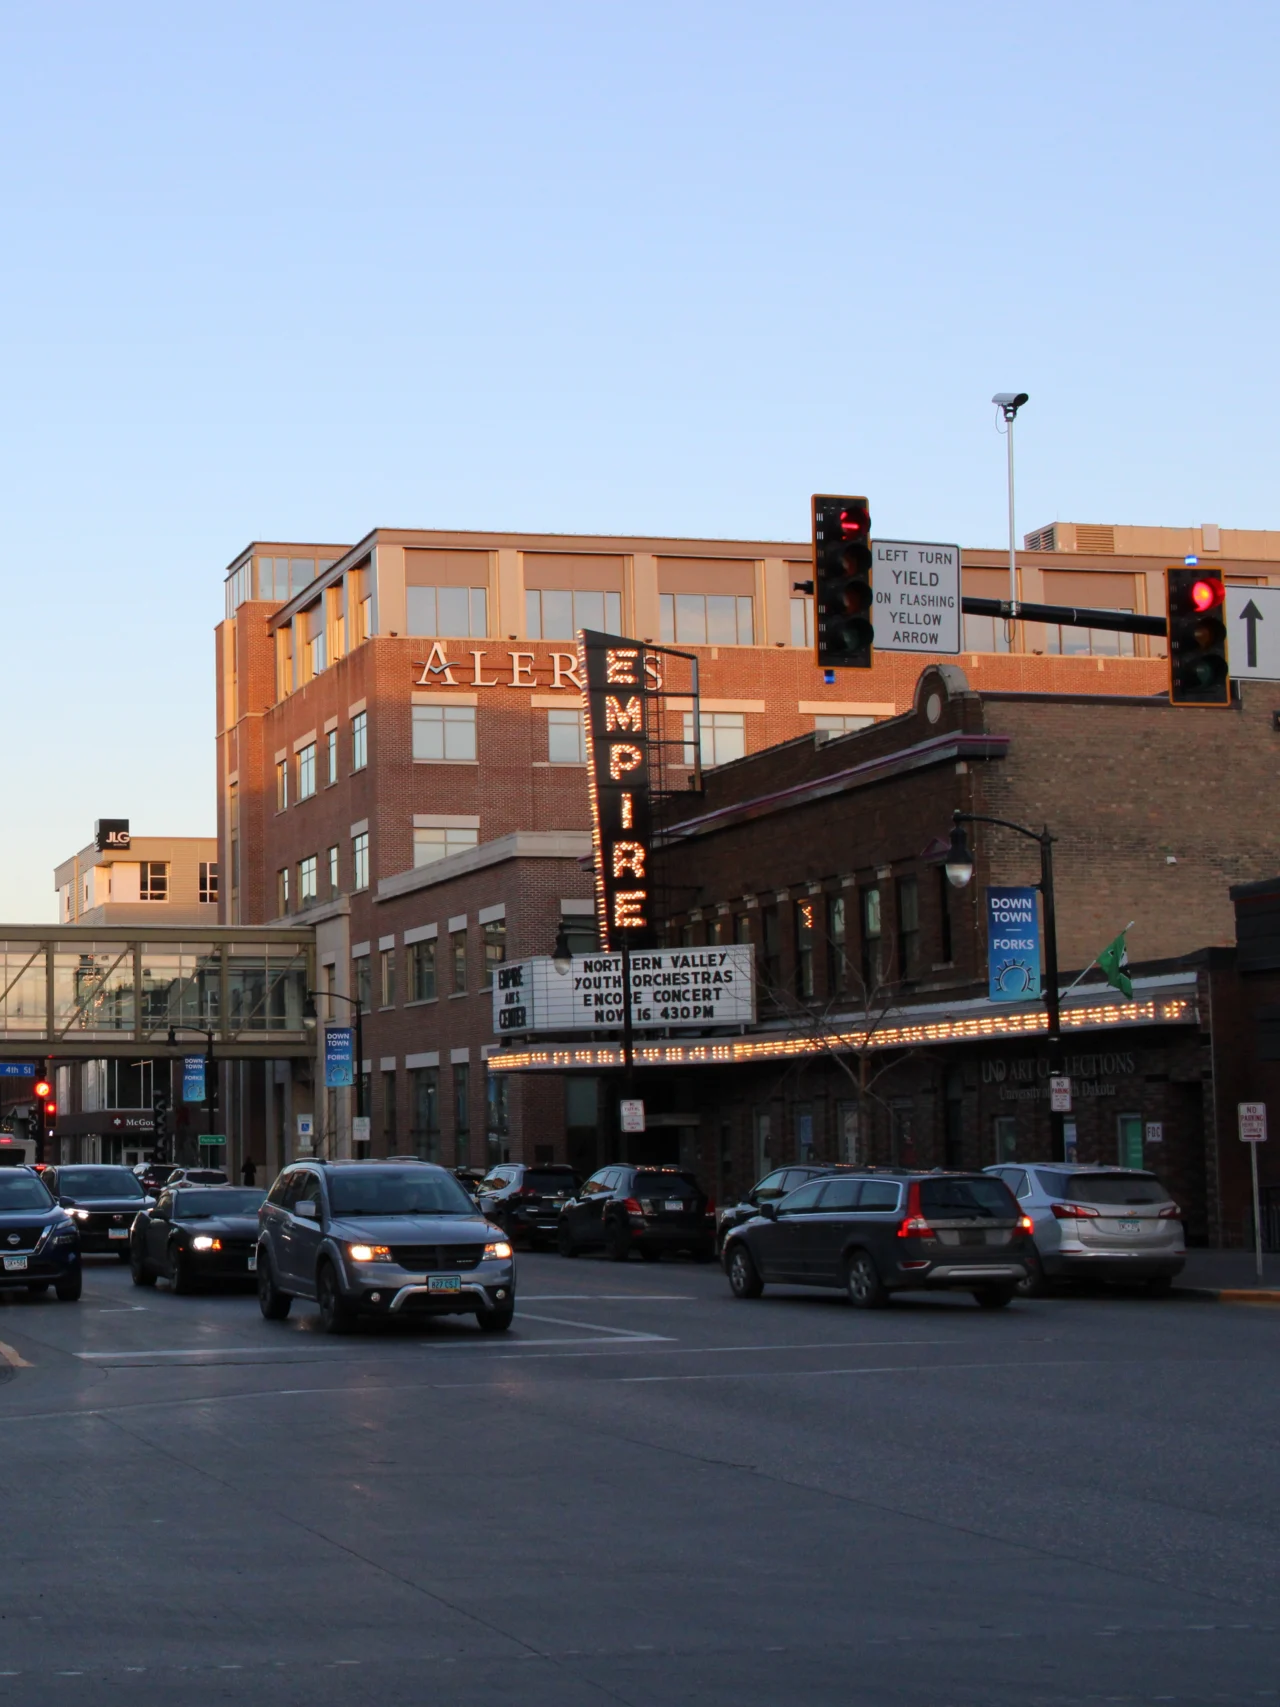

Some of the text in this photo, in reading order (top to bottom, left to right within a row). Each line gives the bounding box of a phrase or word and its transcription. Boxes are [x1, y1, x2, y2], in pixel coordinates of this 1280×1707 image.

[877, 549, 952, 565] LEFT TURN
[892, 569, 939, 587] YIELD
[875, 591, 955, 608] ON FLASHING
[889, 611, 942, 626] YELLOW
[892, 630, 939, 645] ARROW
[415, 642, 663, 691] ALERS
[605, 648, 647, 927] EMPIRE
[105, 831, 130, 844] JLG
[991, 898, 1032, 909] DOWN
[992, 911, 1032, 923] TOWN
[993, 939, 1034, 950] FORKS
[583, 953, 727, 973] NORTERN VALLEY
[574, 970, 733, 990] YOUTH ORCHESTRAS
[583, 987, 722, 1007] ENCOE CONCERT
[594, 1009, 625, 1023] NOV
[637, 1008, 651, 1021] 16
[5, 1066, 19, 1074] 4th
[1009, 1058, 1035, 1081] ART
[1037, 1051, 1135, 1079] CLECTIONS
[999, 1083, 1041, 1103] University
[1082, 1080, 1116, 1097] Dakota
[1246, 1106, 1257, 1114] NO
[1240, 1114, 1264, 1122] PARKING
[1147, 1126, 1161, 1138] FDC
